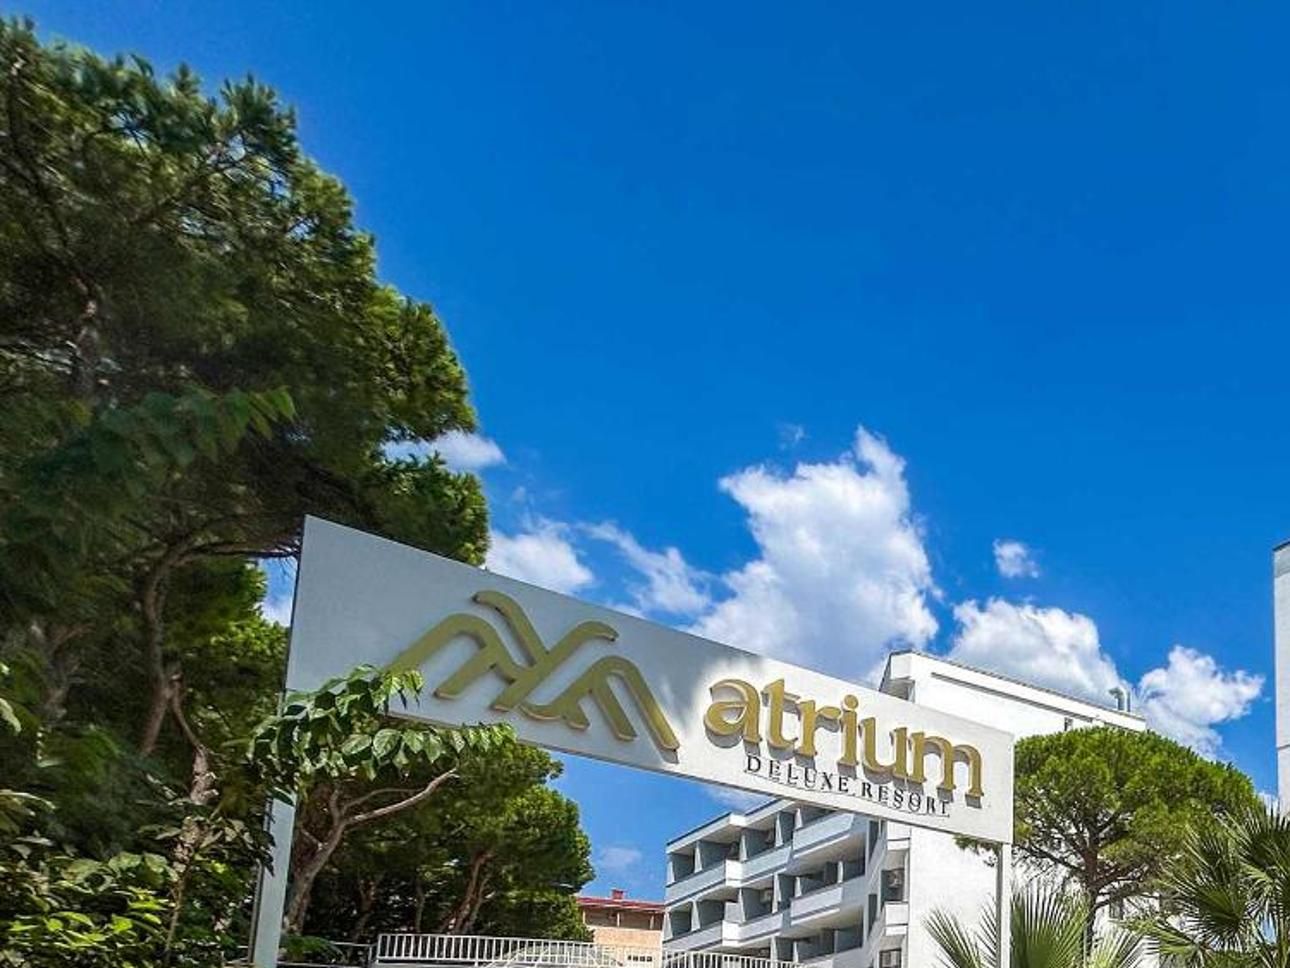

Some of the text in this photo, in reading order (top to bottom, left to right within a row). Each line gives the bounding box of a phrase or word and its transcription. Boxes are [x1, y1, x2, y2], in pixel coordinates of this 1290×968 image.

[703, 678, 984, 797] atrium
[746, 754, 951, 816] DELUXE RESORT
